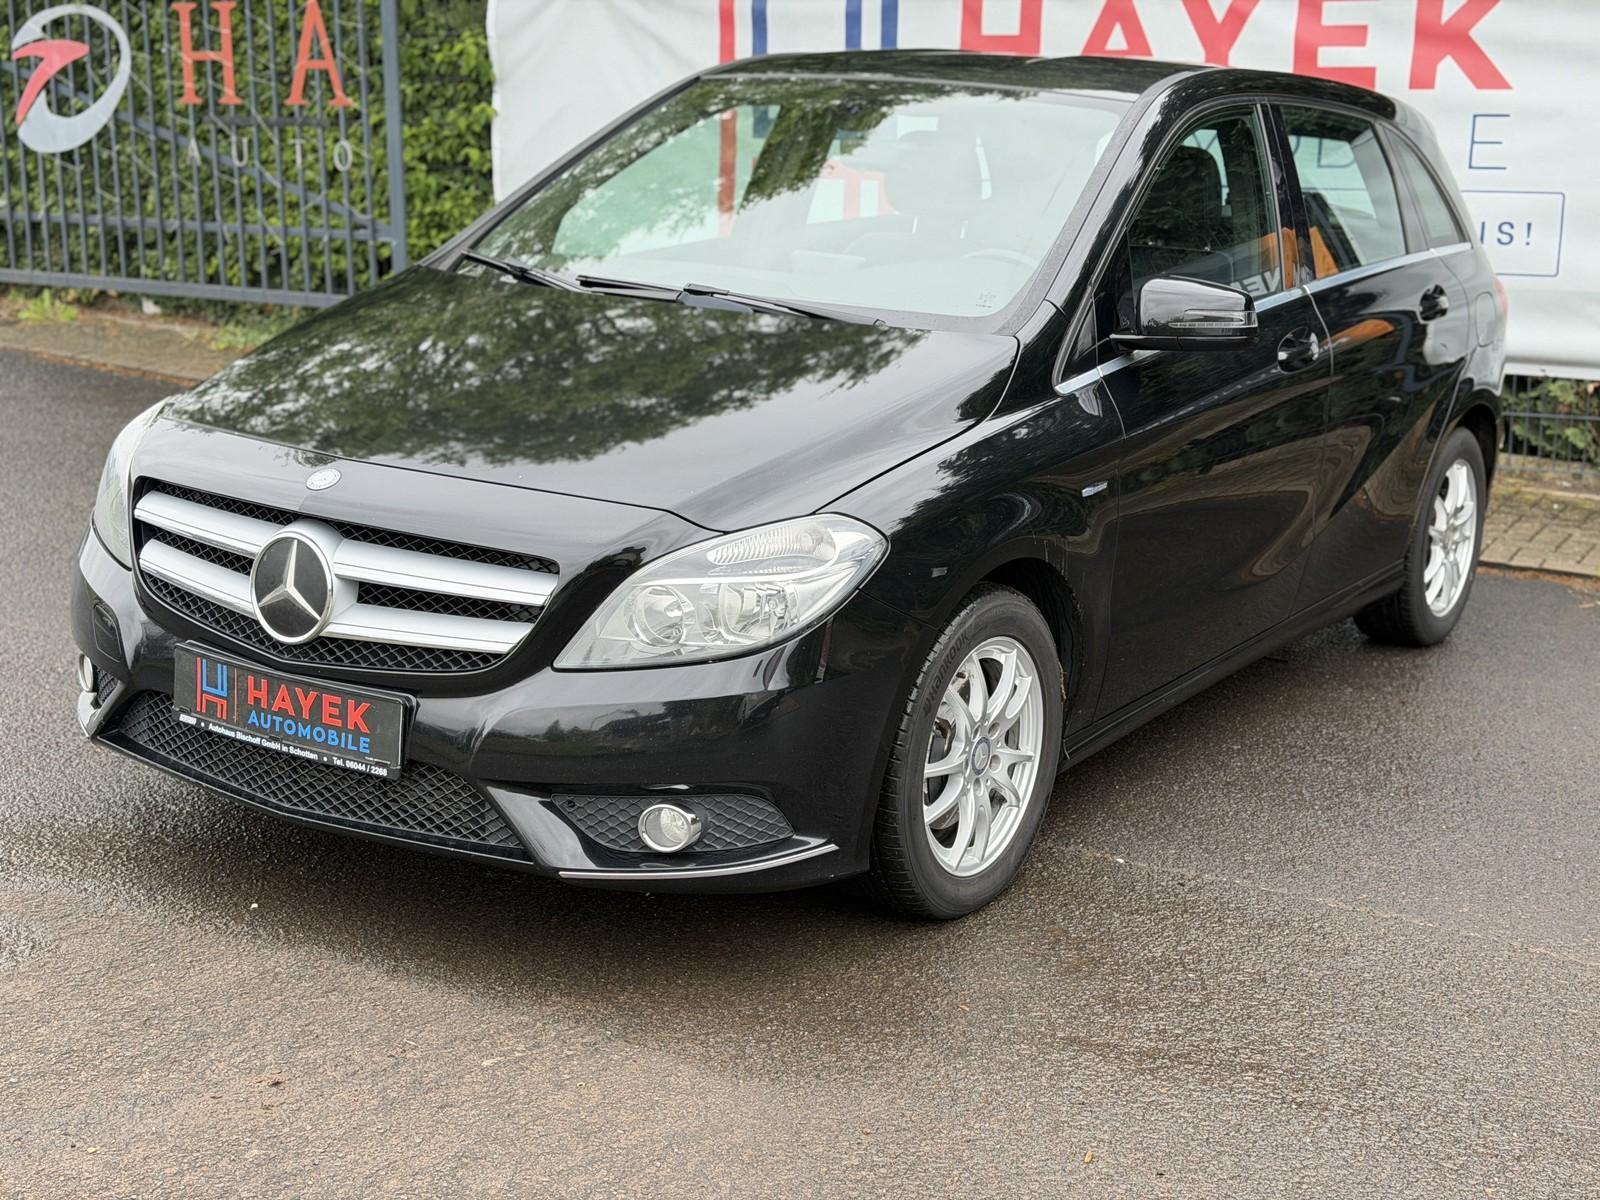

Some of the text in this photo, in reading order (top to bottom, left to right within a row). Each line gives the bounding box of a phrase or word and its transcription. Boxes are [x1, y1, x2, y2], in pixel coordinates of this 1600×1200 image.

[246, 675, 371, 734] HAYEK
[208, 722, 235, 737] Autohaus
[236, 731, 261, 744] Bischoff
[261, 738, 281, 750] GmbH
[289, 745, 318, 760] Schotten
[332, 756, 345, 767] Tel.
[247, 710, 371, 754] AUTOMOBILE
